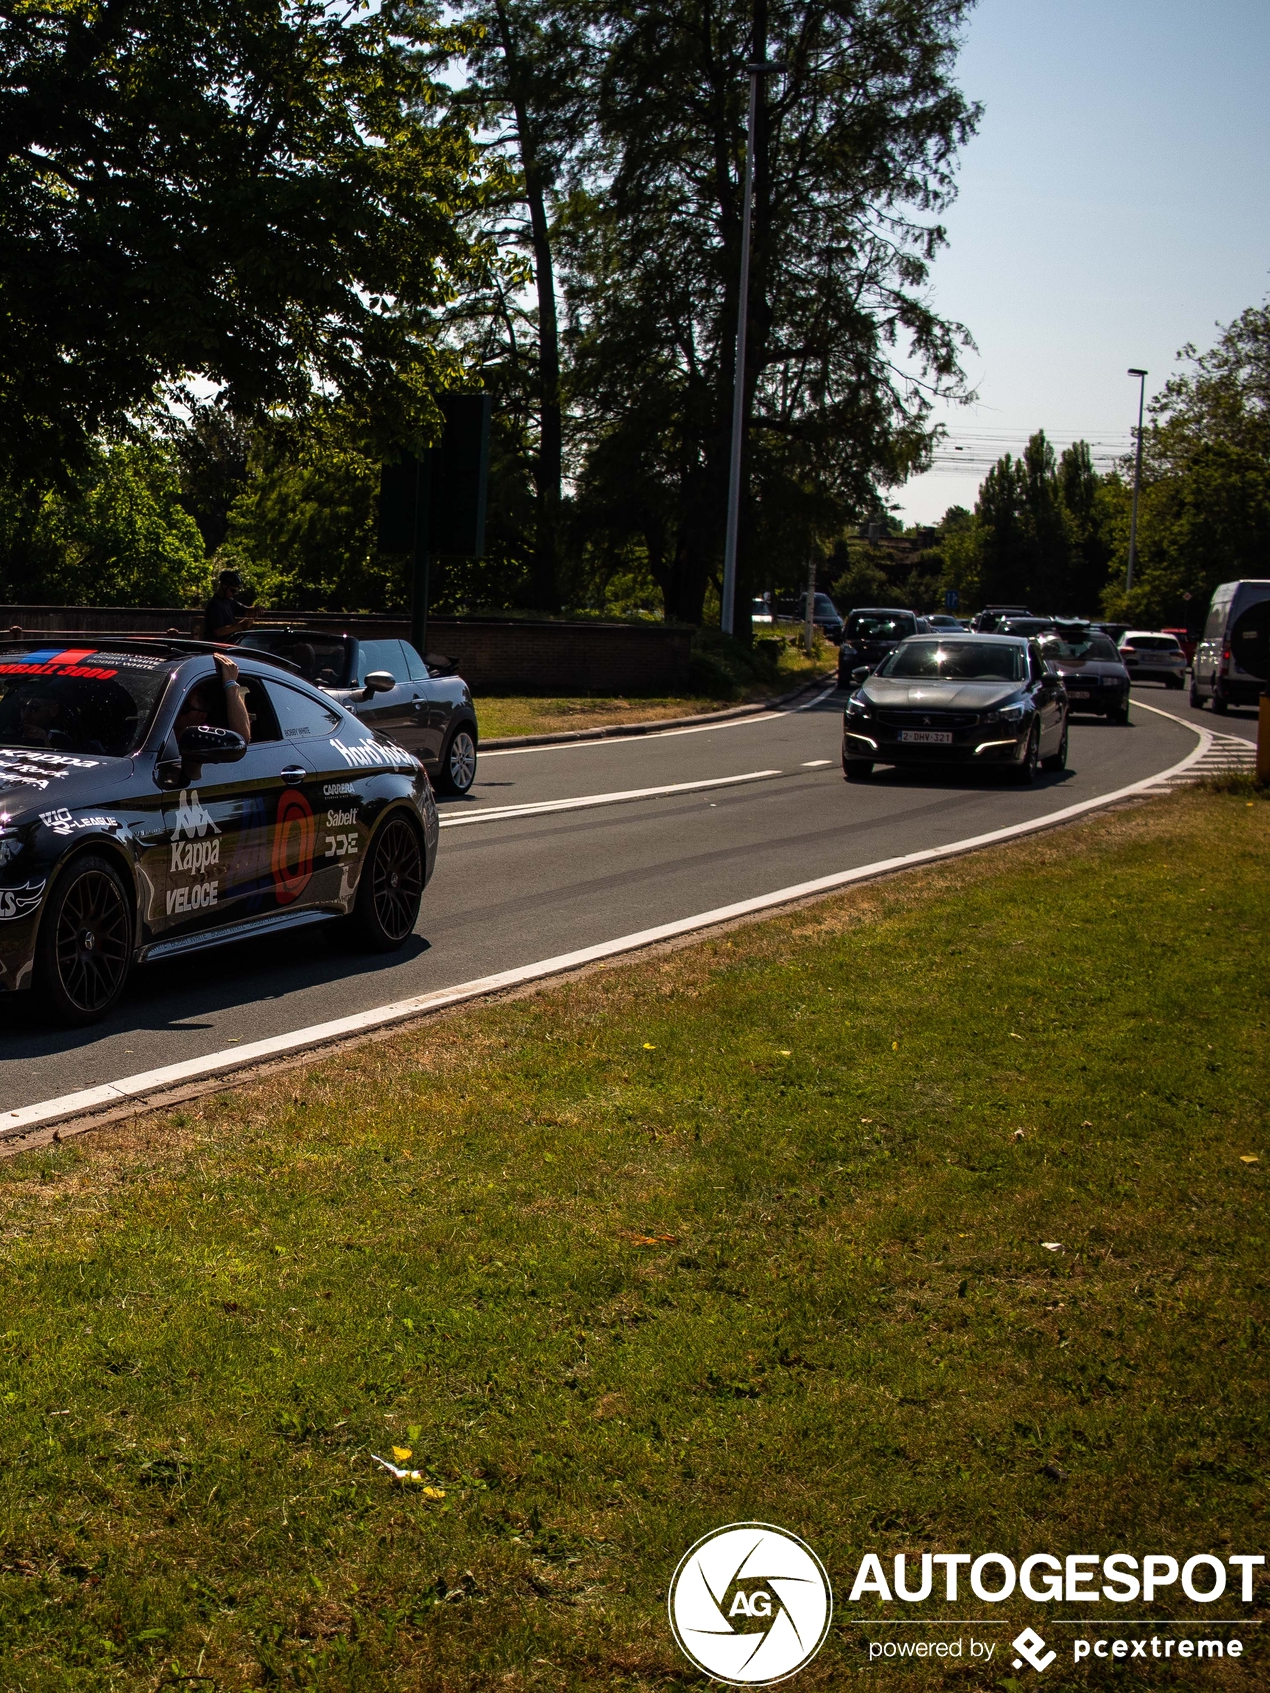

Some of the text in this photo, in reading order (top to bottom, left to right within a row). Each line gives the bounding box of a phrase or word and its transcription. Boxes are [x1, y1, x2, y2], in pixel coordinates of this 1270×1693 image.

[129, 657, 161, 666] WHITE
[134, 654, 167, 662] WHITE
[57, 665, 118, 680] 3000
[122, 662, 155, 670] WHITE
[323, 783, 356, 796] CARRERA
[326, 808, 358, 828] Sabelt
[170, 838, 220, 875] Kappa
[166, 880, 219, 915] VELOCE
